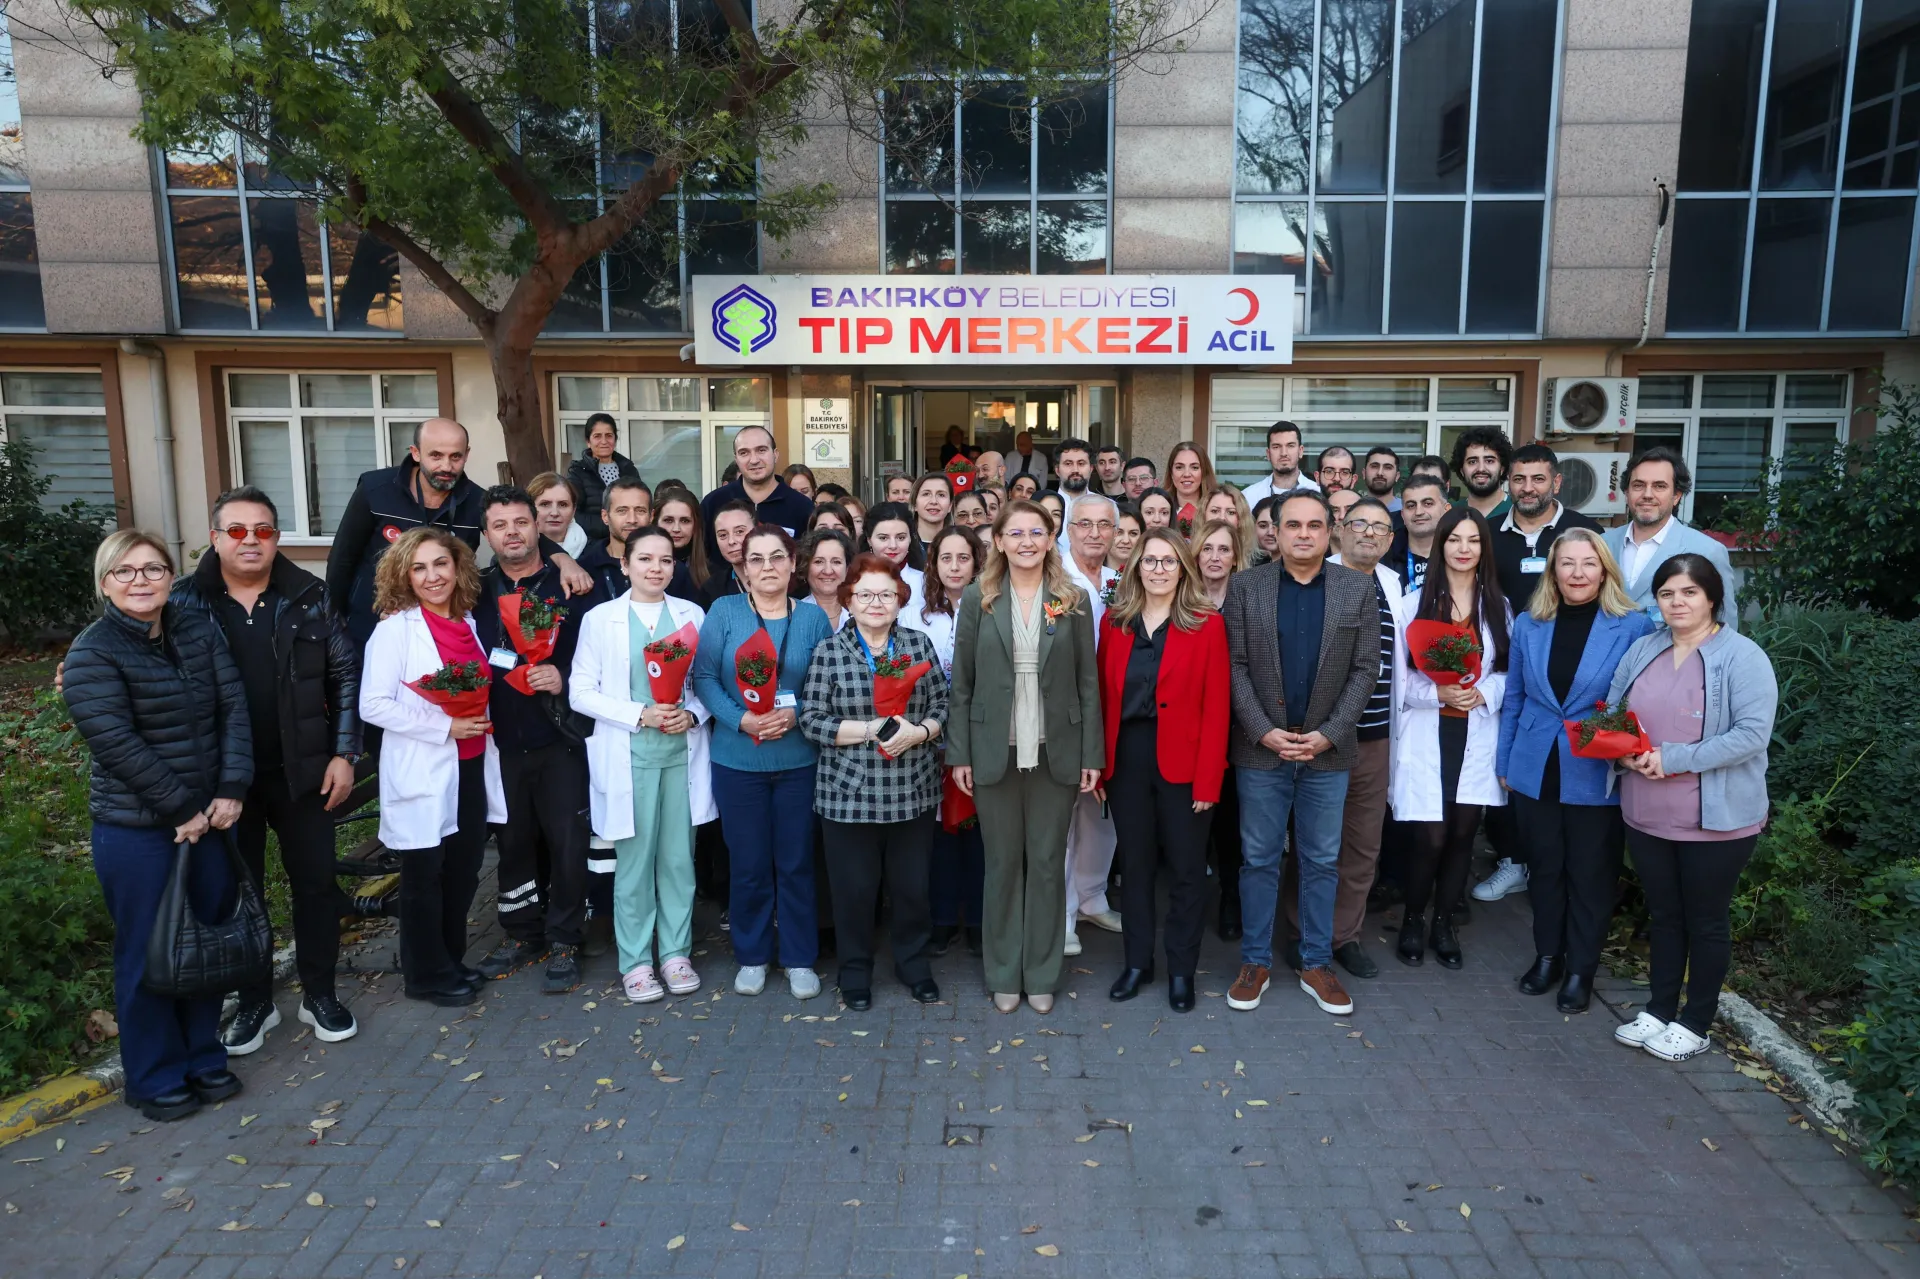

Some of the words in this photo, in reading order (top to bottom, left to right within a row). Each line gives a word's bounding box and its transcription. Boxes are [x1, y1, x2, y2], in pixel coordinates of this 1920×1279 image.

[811, 286, 991, 308] BAKIRKÖY
[1000, 286, 1176, 308] BELEDİYESİ
[798, 317, 893, 354] TIP
[909, 315, 1189, 354] MERKEZİ
